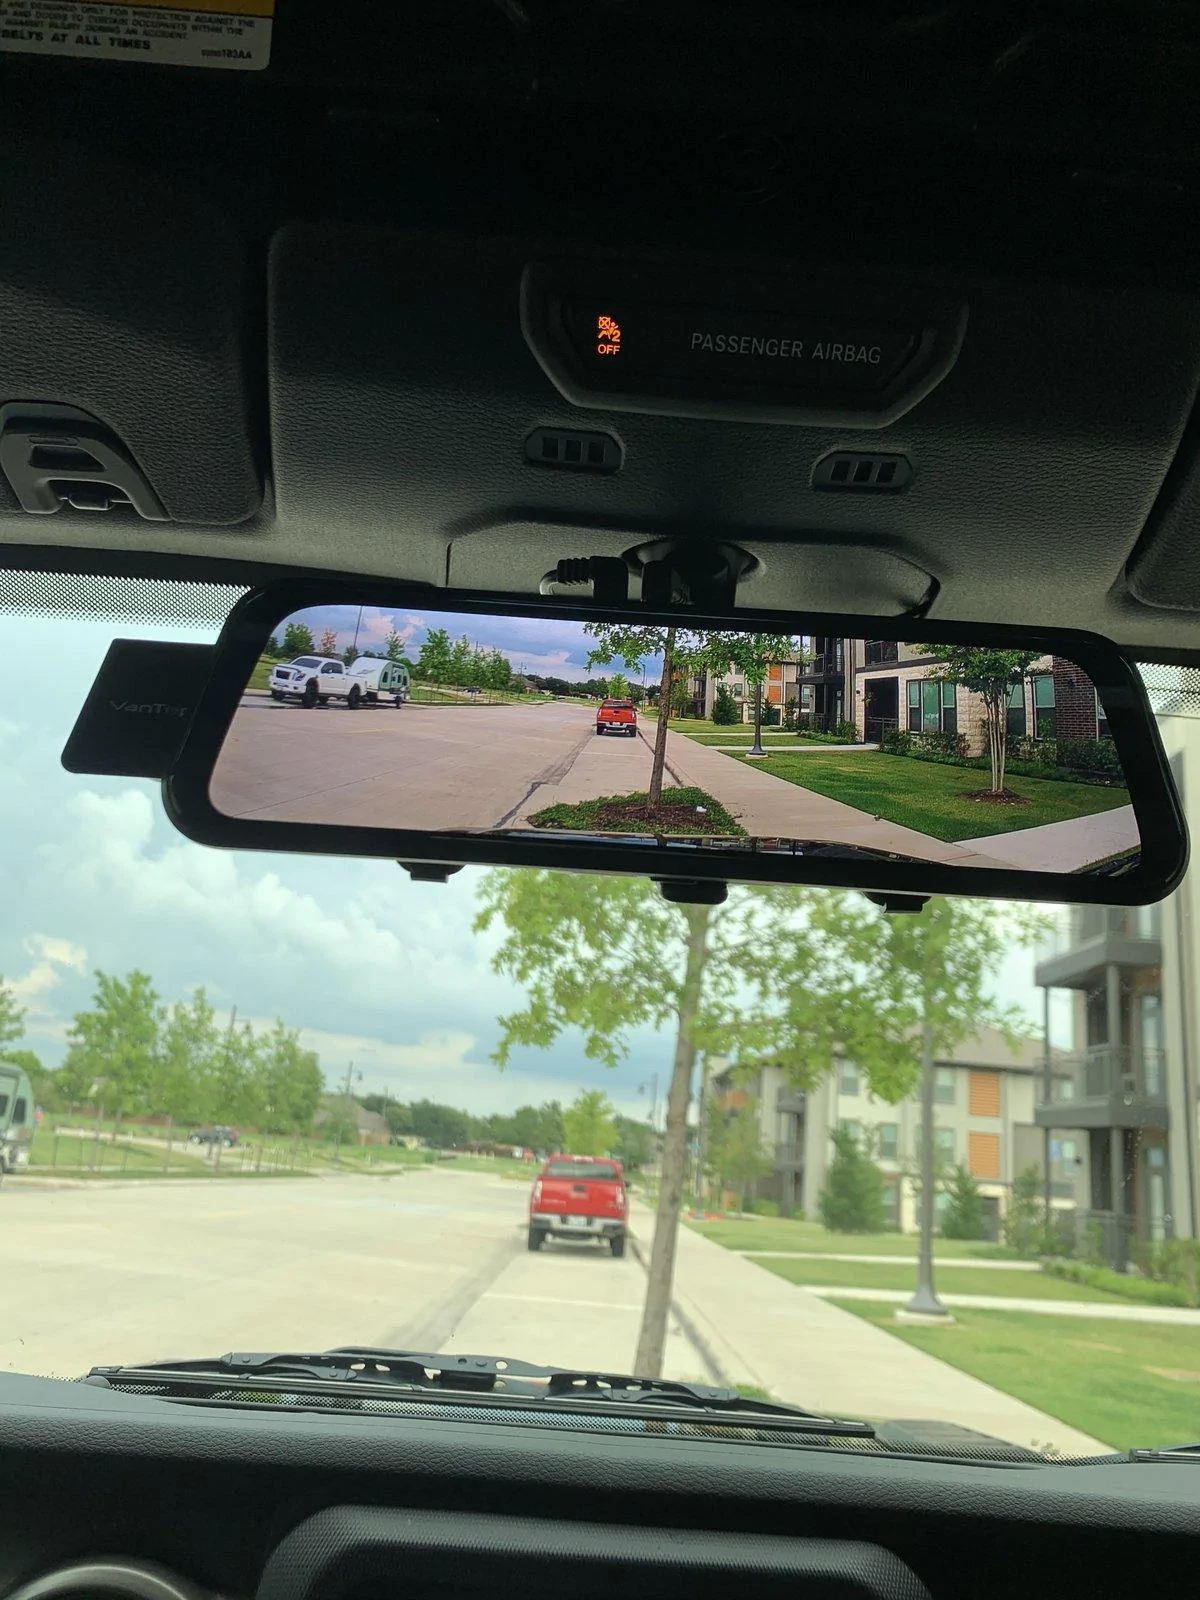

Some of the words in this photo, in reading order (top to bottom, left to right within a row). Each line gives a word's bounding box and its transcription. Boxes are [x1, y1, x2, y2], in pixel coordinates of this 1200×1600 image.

[2, 29, 44, 41] BELTS
[51, 33, 68, 42] AT
[75, 35, 101, 45] ALL
[108, 36, 151, 49] TIMES
[597, 343, 621, 356] OFF
[691, 332, 803, 358] PASSENGER
[811, 342, 882, 364] AIRBAG
